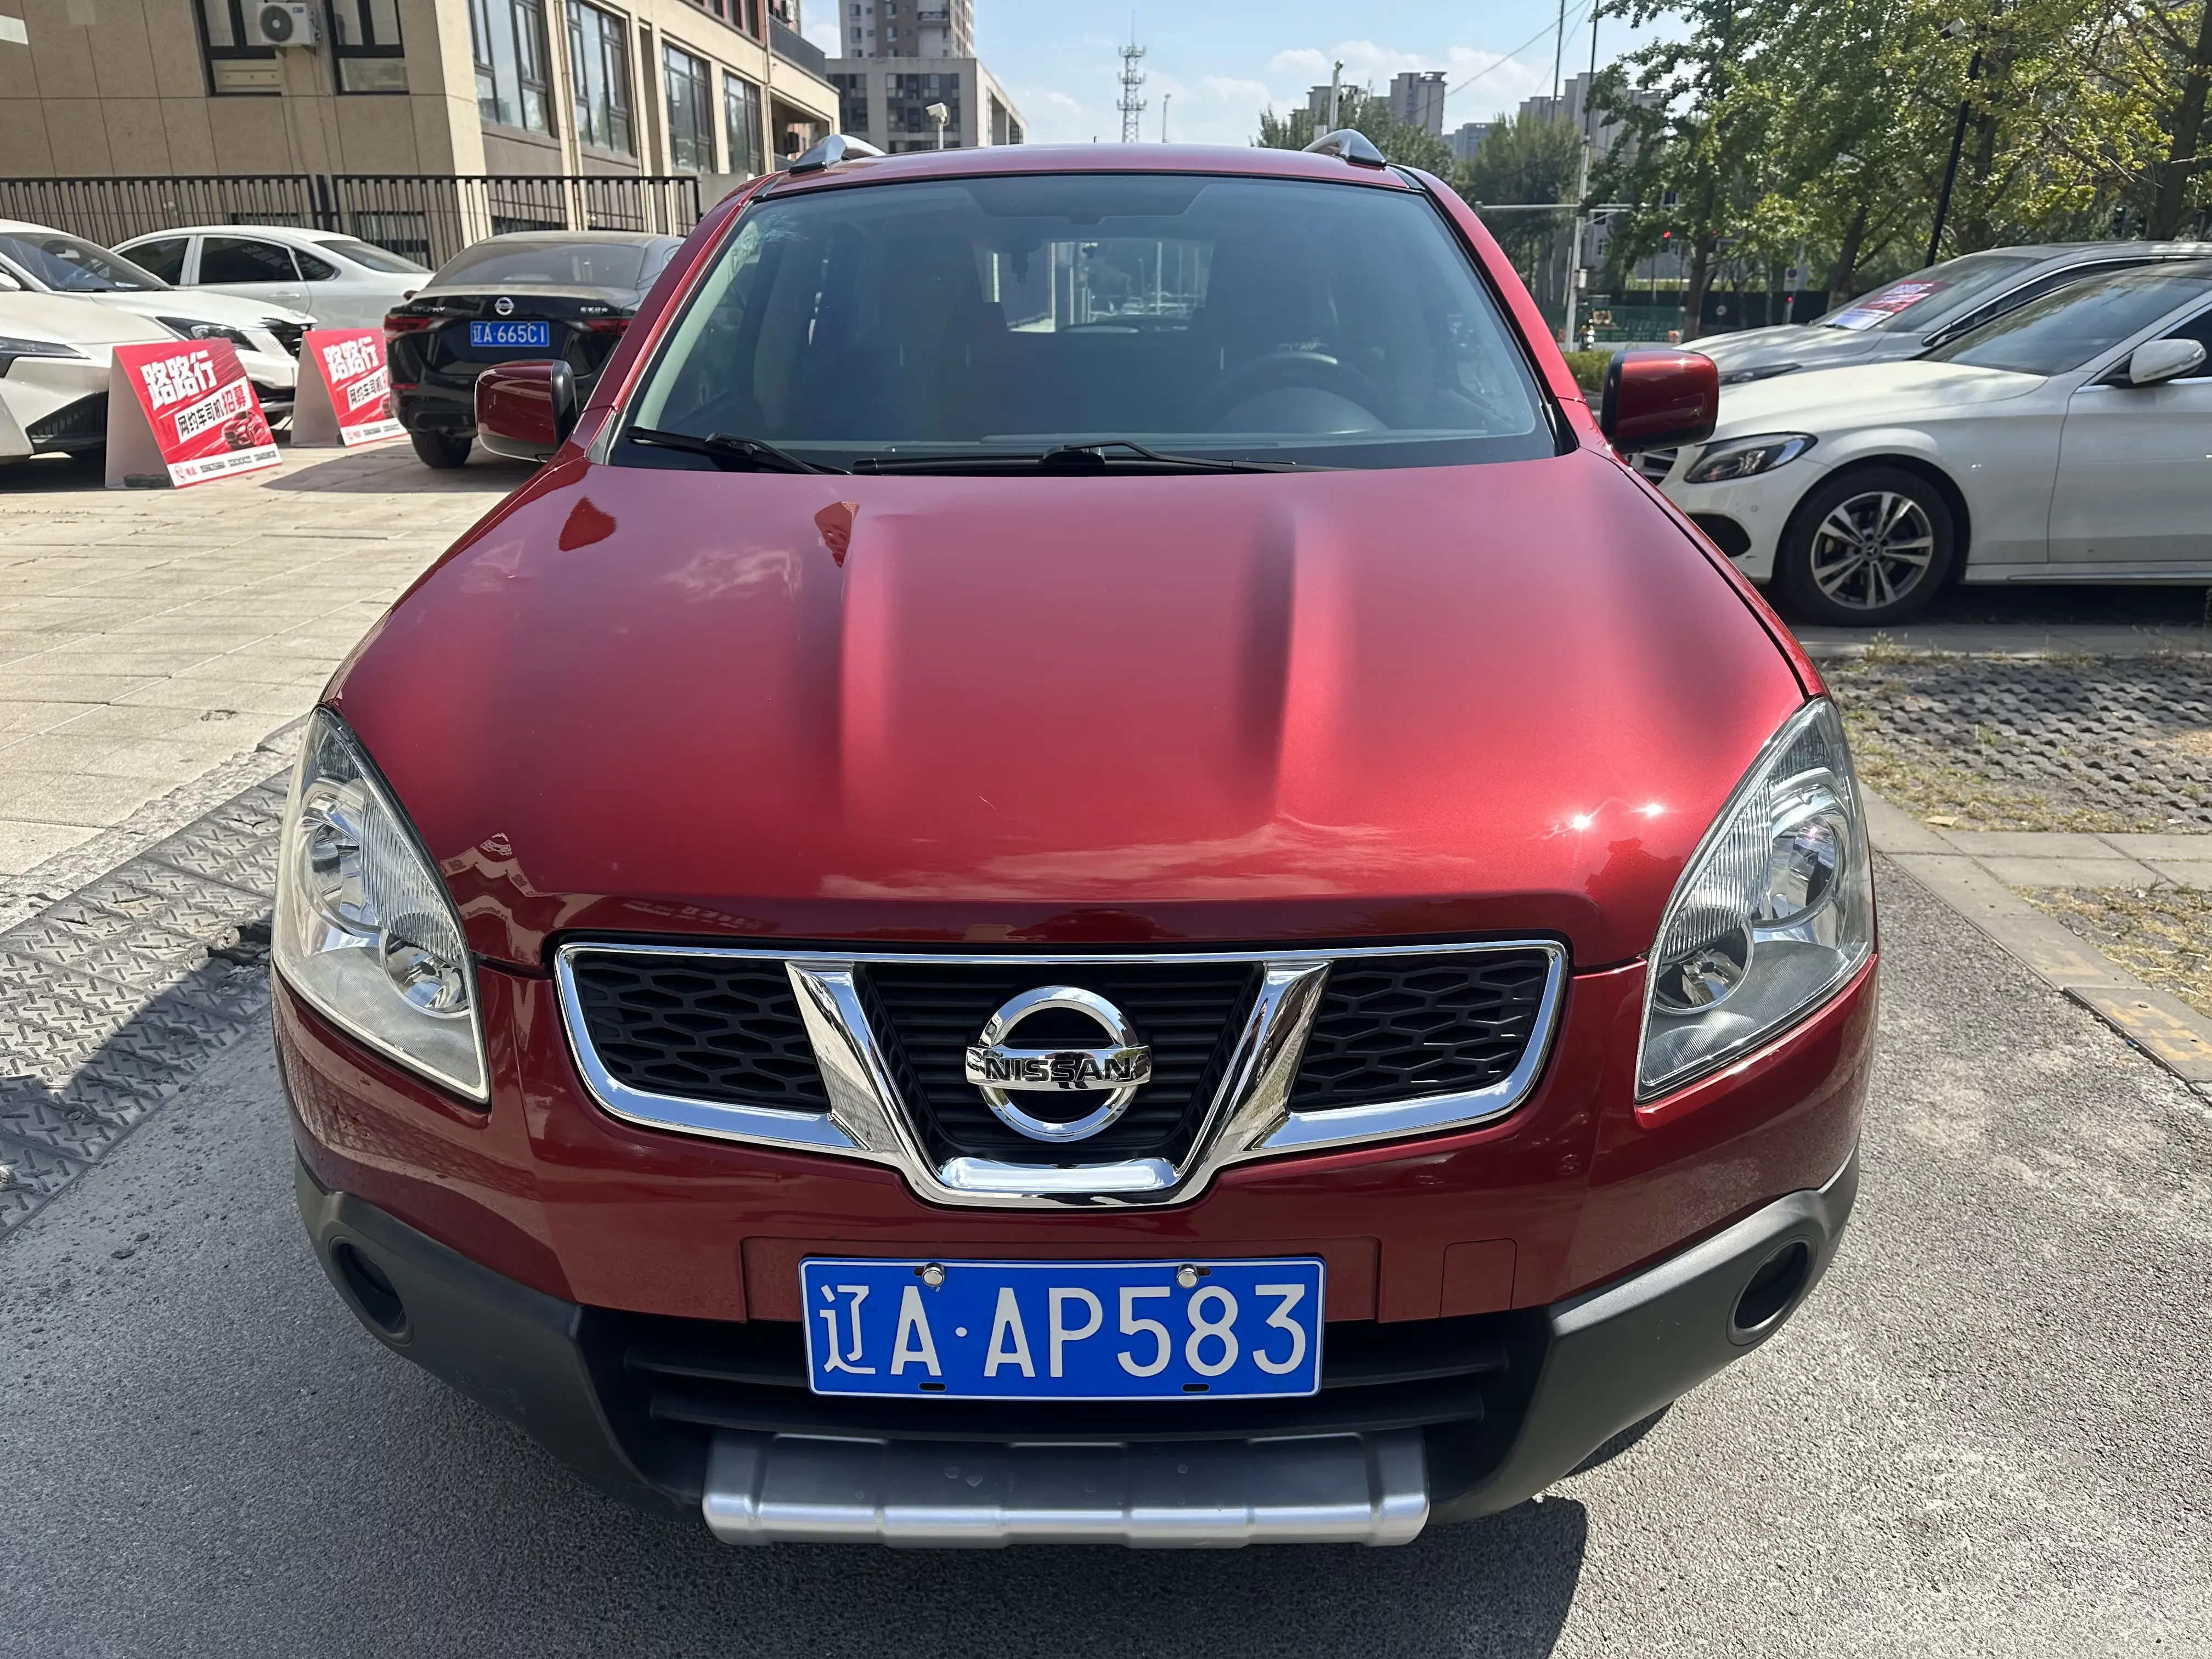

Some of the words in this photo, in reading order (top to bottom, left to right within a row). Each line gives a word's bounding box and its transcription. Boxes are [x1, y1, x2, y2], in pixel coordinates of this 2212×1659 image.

[140, 349, 217, 411] 路路行
[322, 336, 379, 384] 路路行
[985, 1057, 1131, 1082] NISSAN
[820, 1283, 1306, 1378] 辽A·AP583
